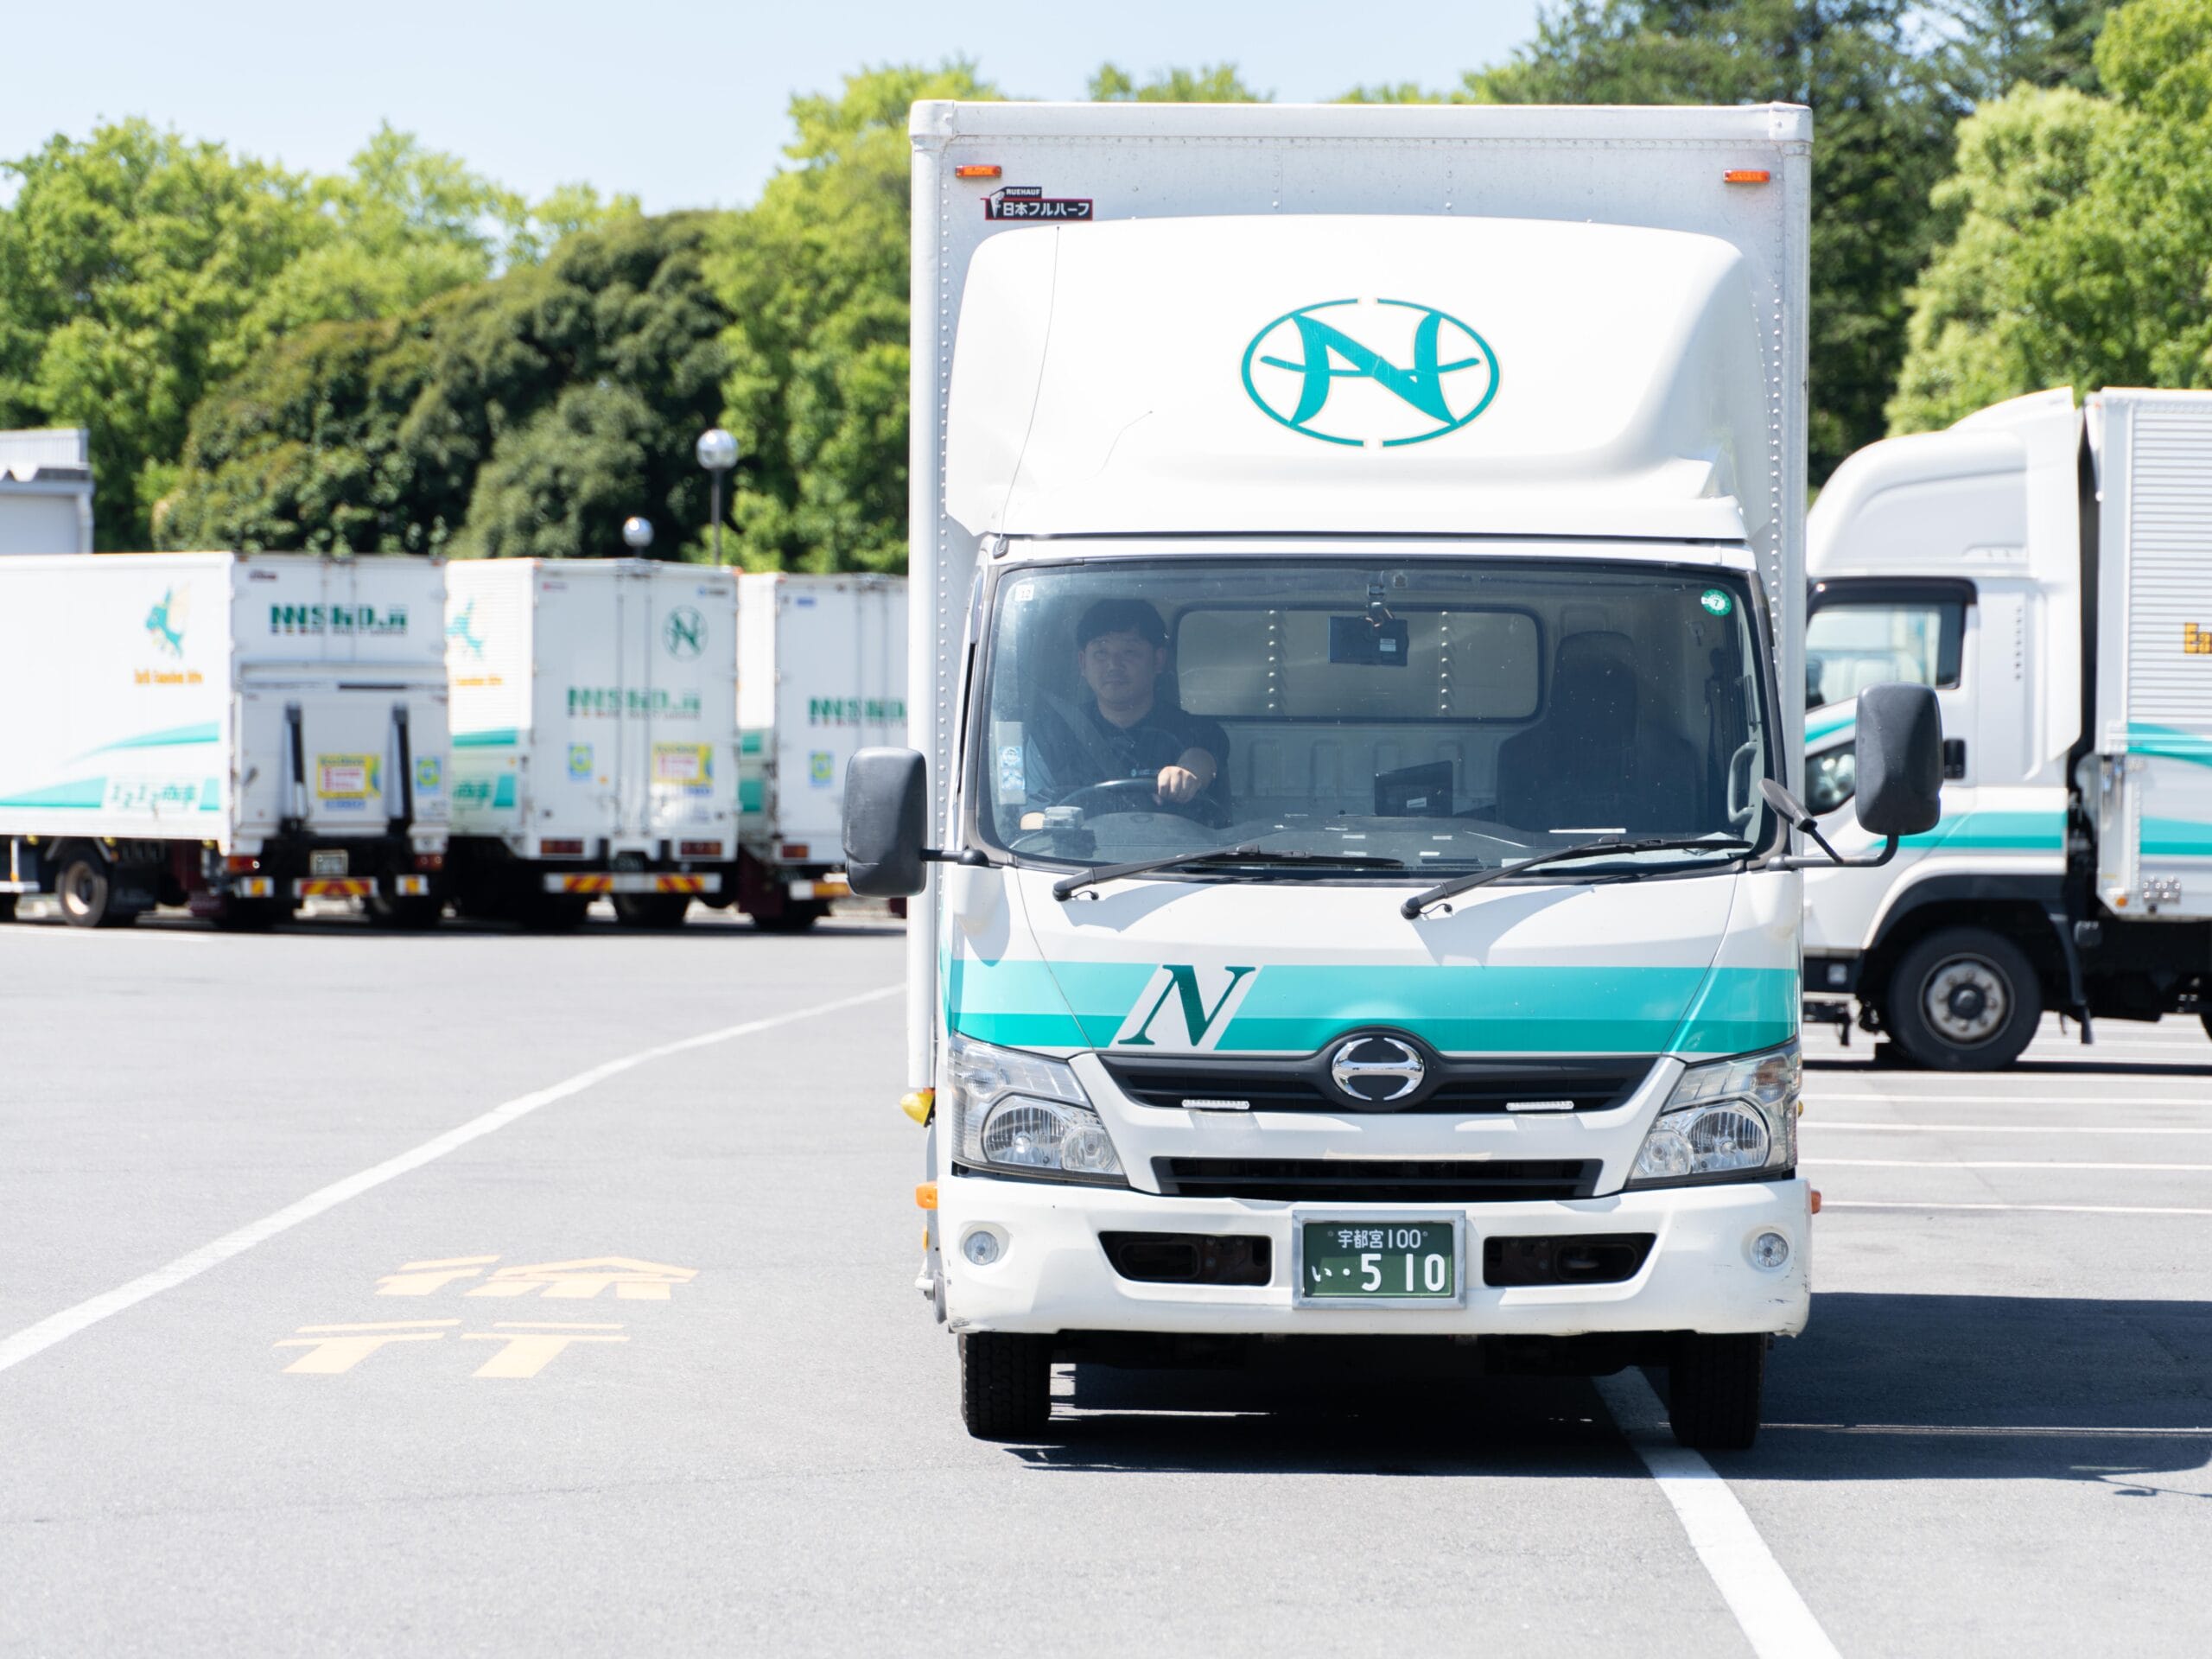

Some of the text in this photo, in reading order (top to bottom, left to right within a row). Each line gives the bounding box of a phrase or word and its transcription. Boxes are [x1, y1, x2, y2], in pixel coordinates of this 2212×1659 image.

[1003, 201, 1090, 217] 日本フルハーフ
[1117, 964, 1256, 1046] N
